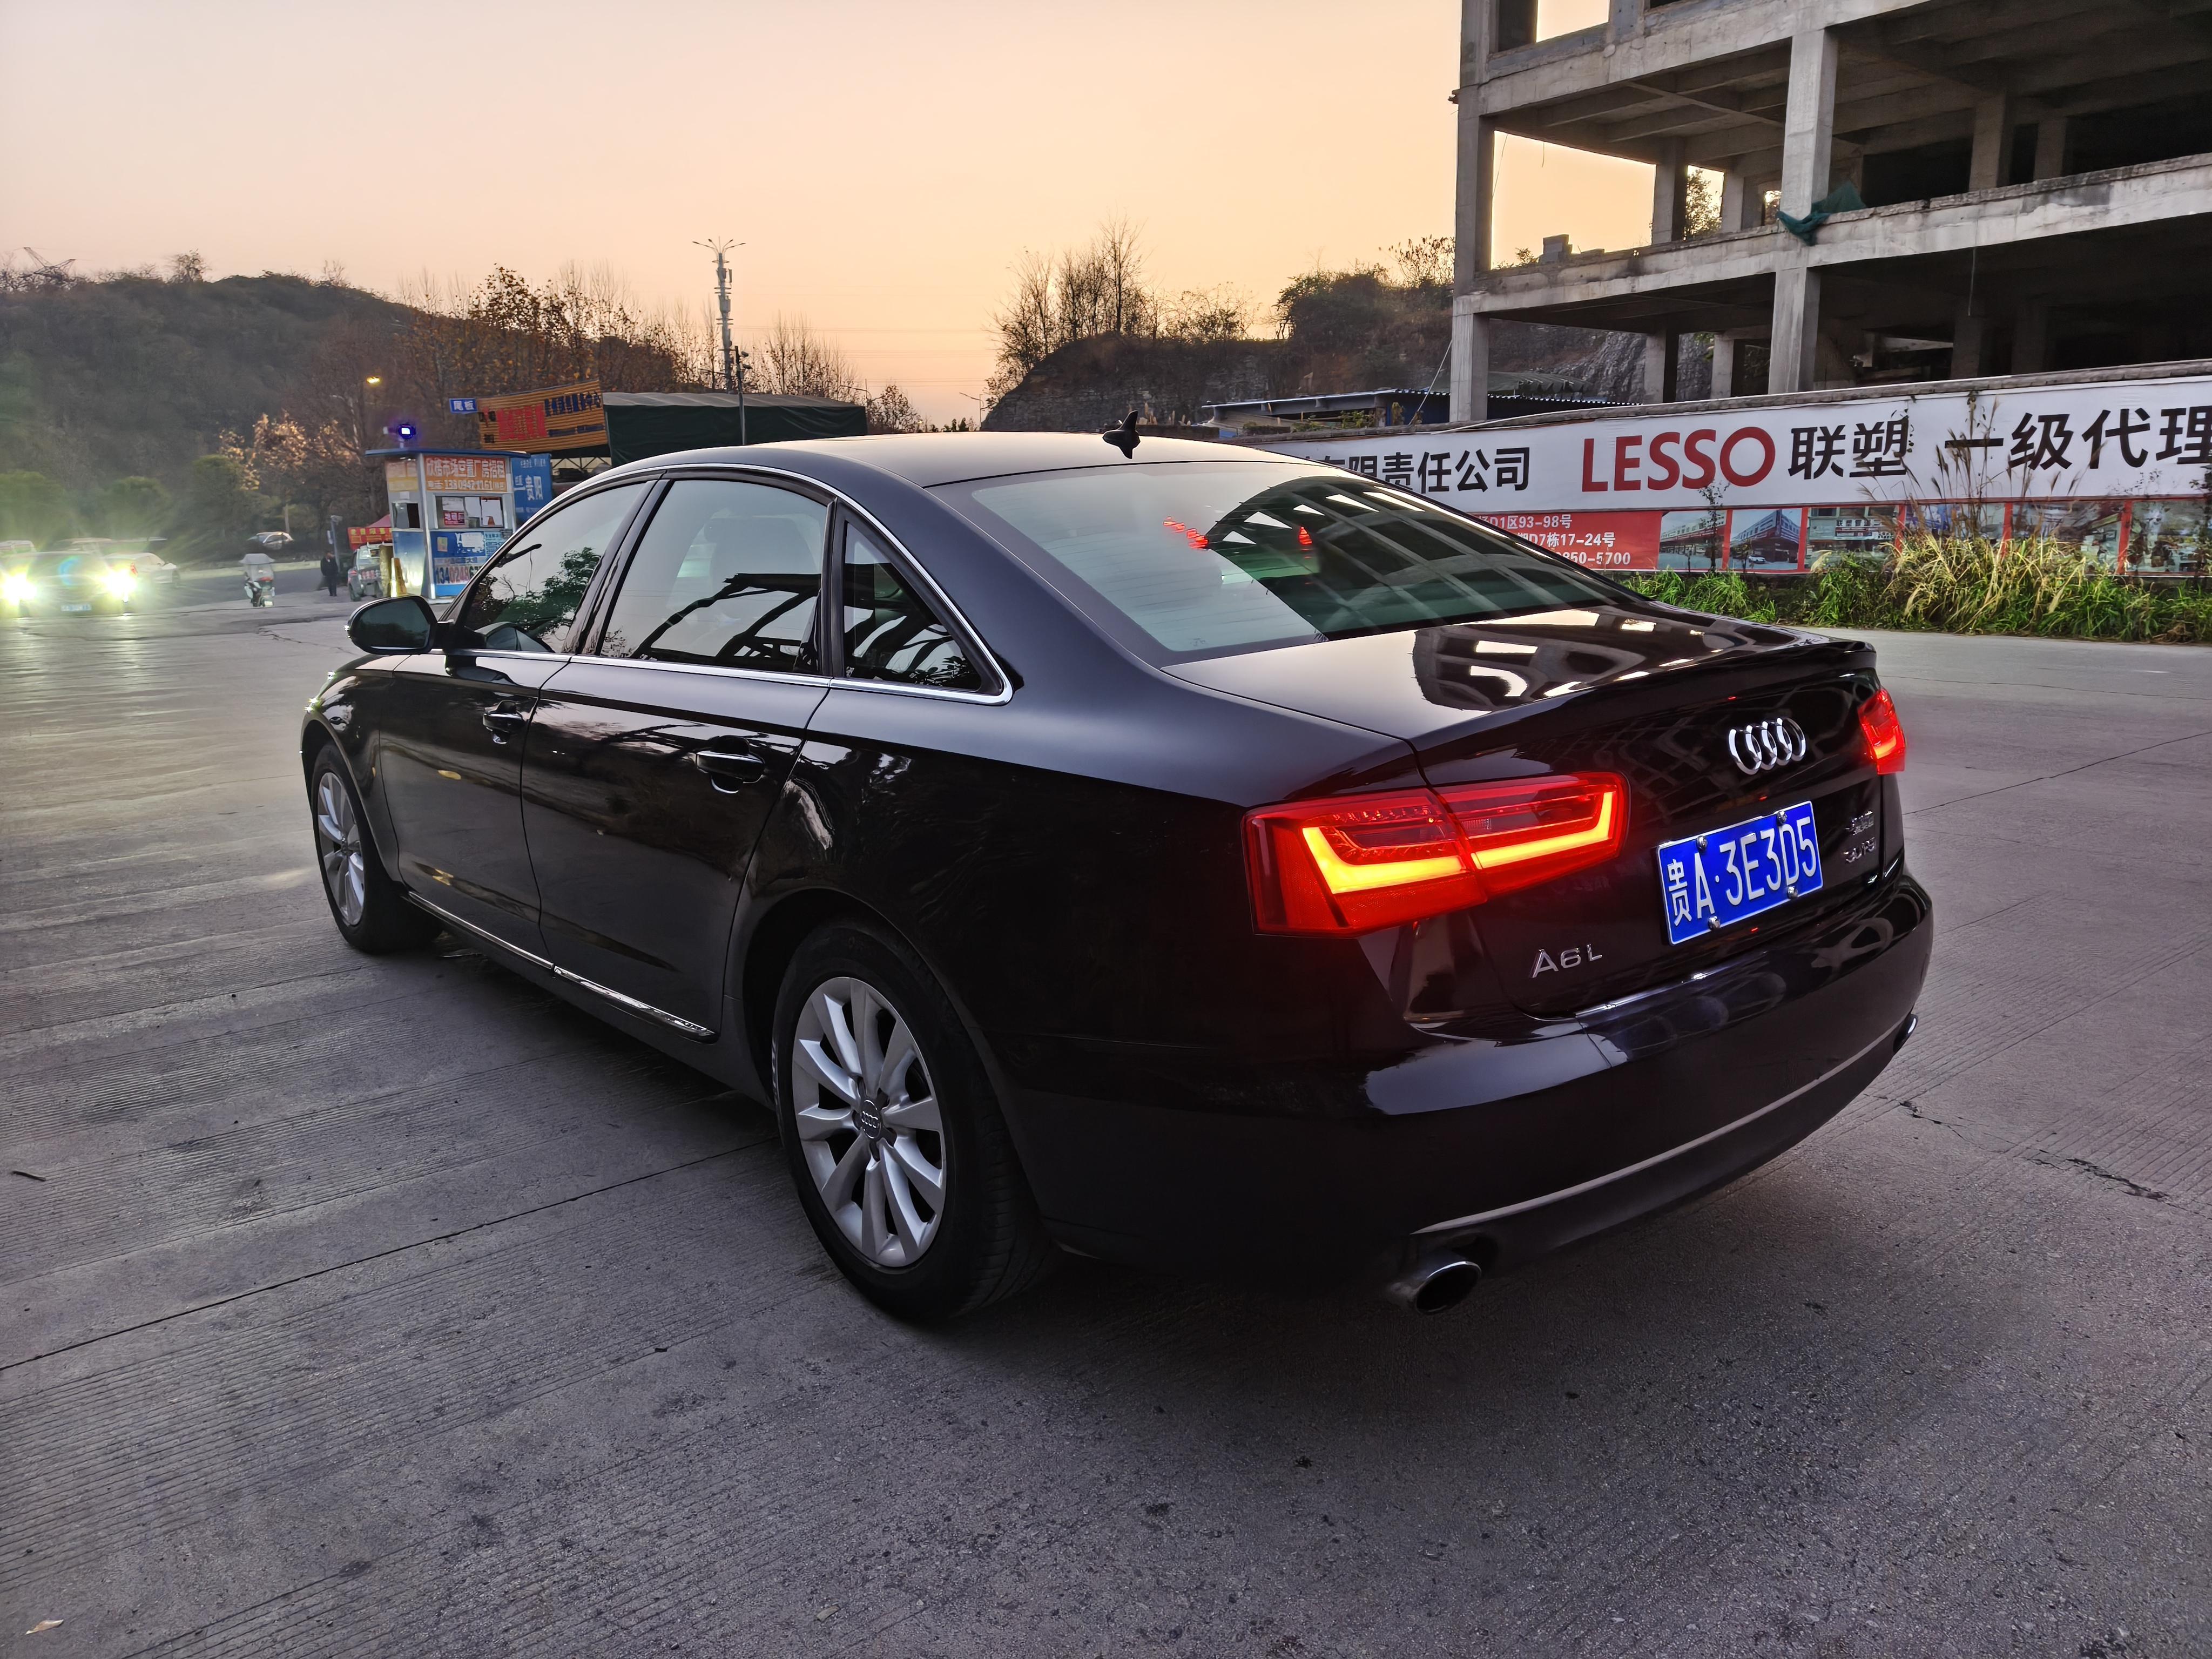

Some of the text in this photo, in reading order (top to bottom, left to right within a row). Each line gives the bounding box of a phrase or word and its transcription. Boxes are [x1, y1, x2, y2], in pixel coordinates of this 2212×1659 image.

[1582, 427, 1776, 492] LESSO
[1788, 406, 2212, 480] 联塑 一级代理
[1314, 447, 1530, 494] 限责任公司
[1555, 551, 1631, 565] 850-5700
[1529, 943, 1603, 979] A6L
